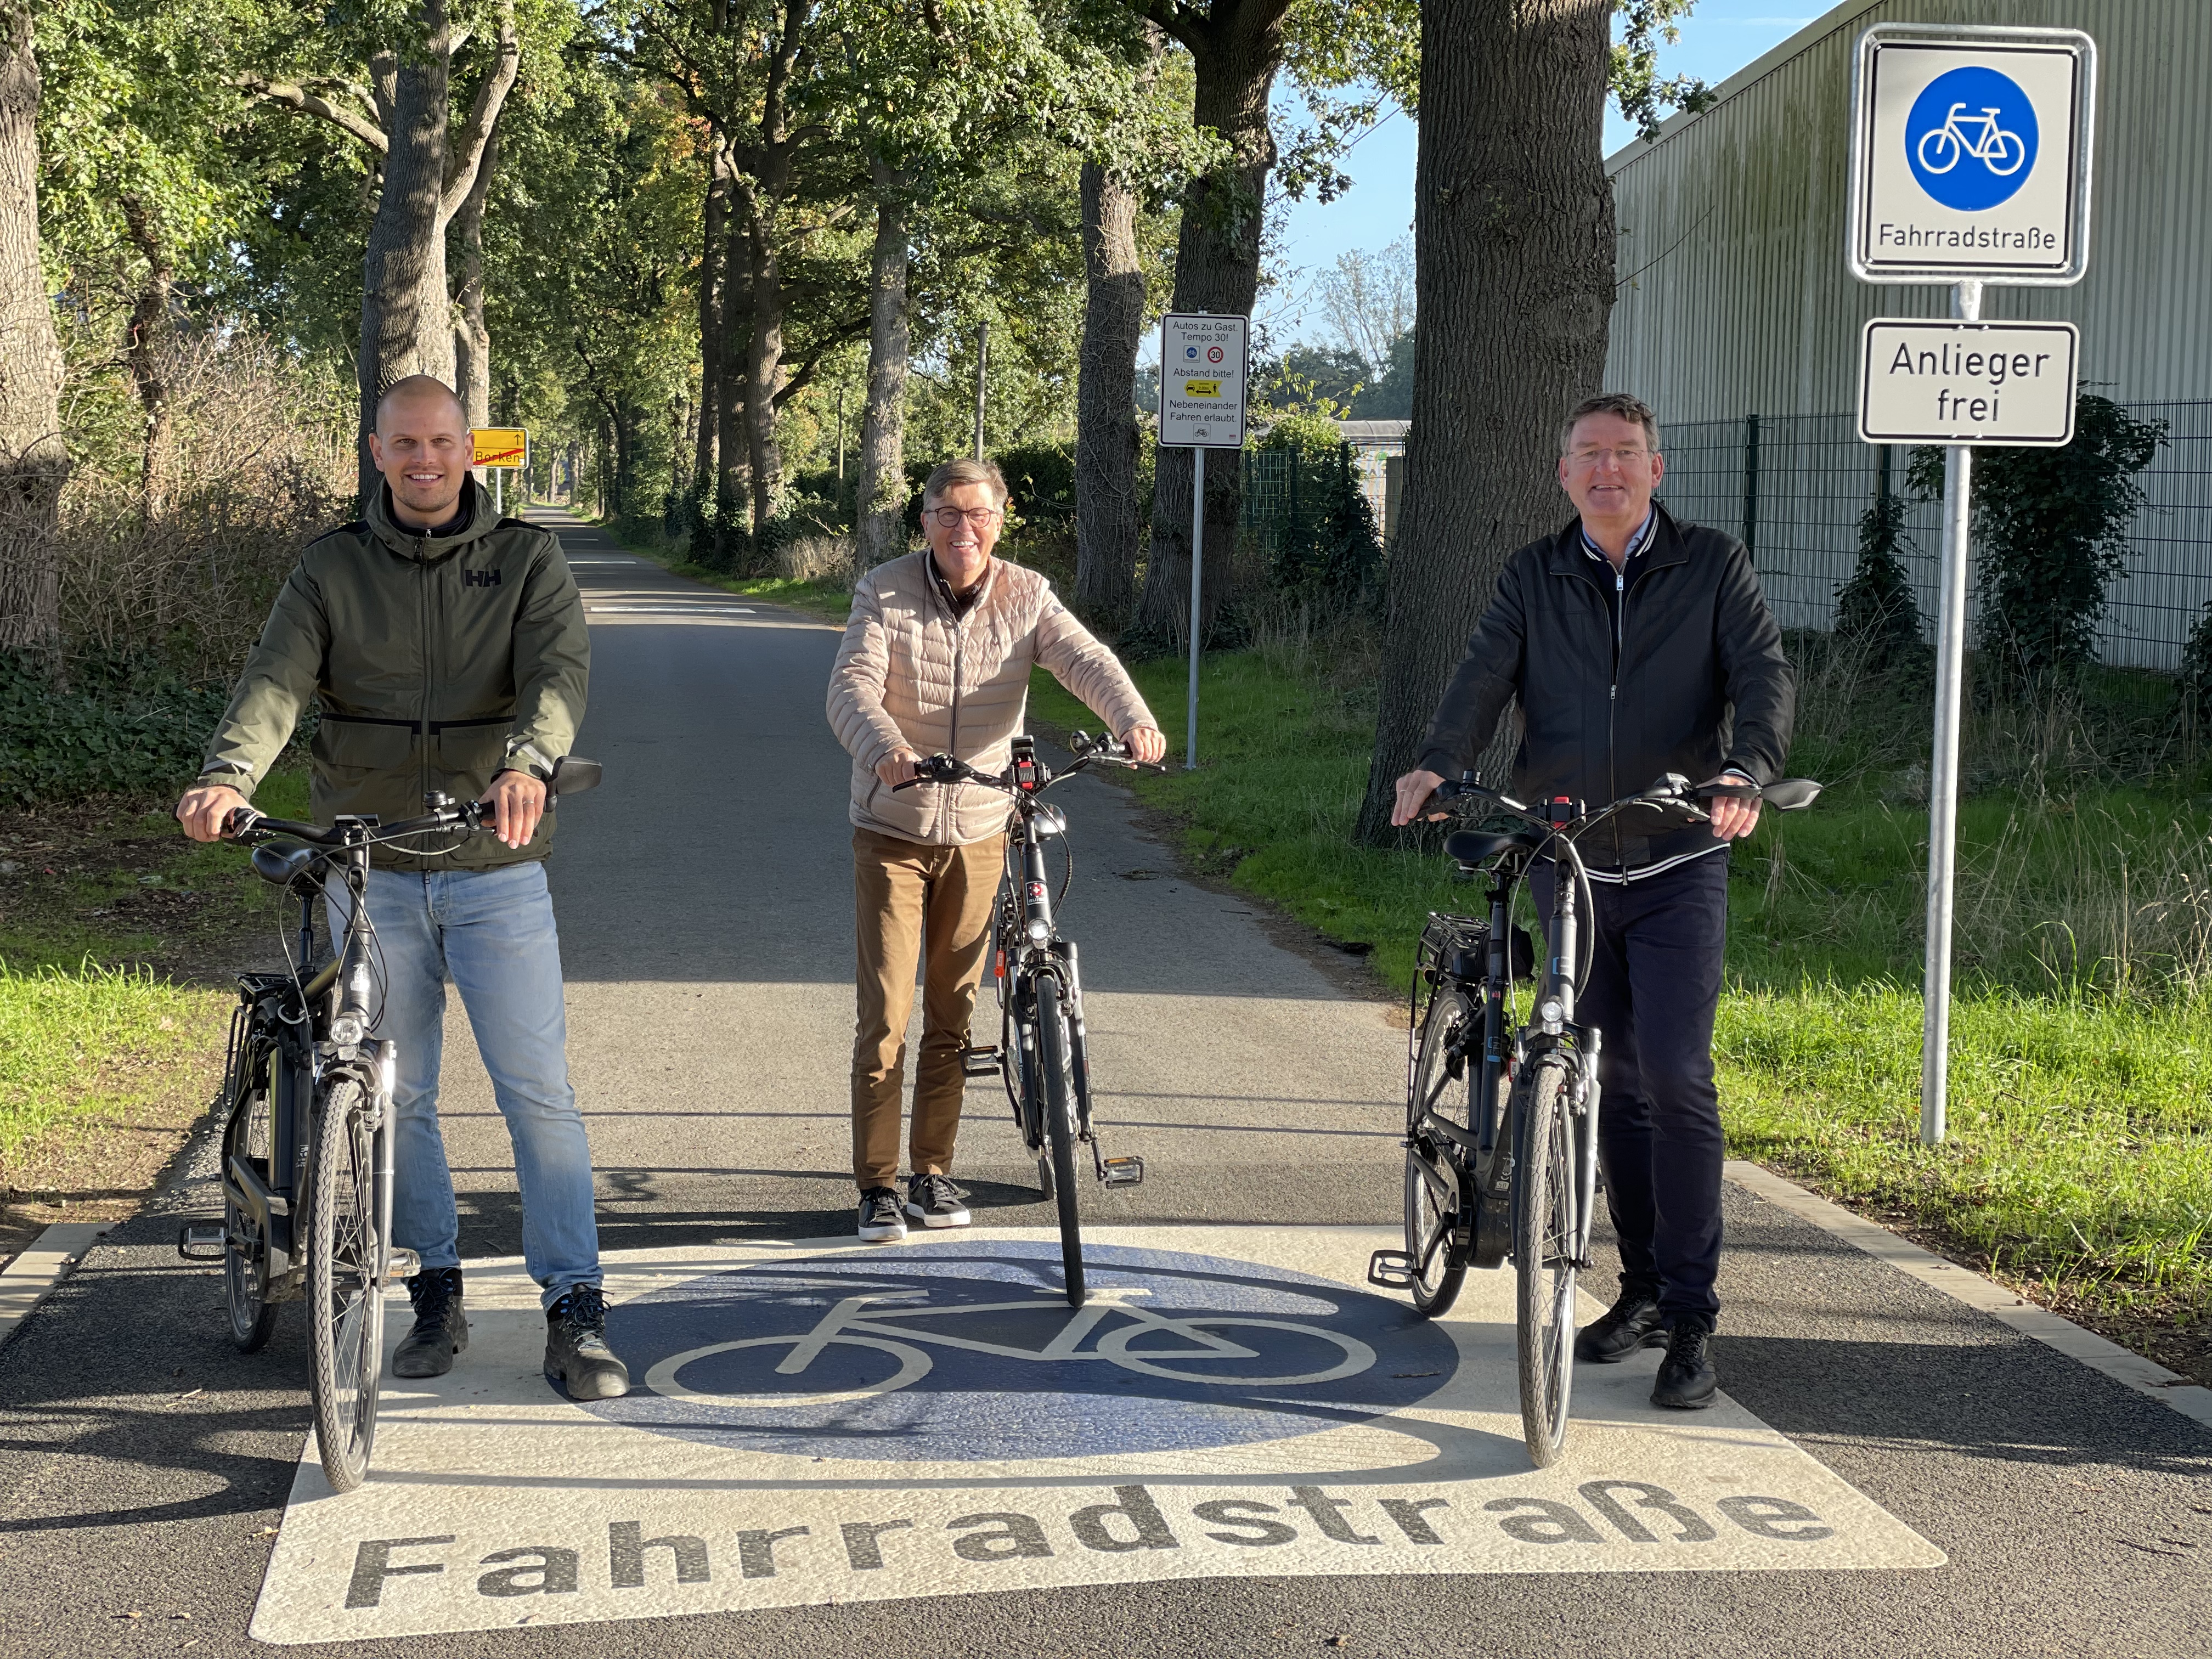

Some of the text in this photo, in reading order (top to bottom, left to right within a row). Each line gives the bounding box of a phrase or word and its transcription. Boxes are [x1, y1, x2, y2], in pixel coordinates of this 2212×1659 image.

[1879, 223, 2057, 250] Fahrradstraße
[1172, 321, 1199, 330] Autos
[1215, 323, 1238, 332] Gast.
[1181, 332, 1228, 343] Tempo 30!
[1889, 342, 2051, 385] Anlieger
[1173, 368, 1234, 379] Abstand bitte!
[1170, 399, 1238, 410] Nebeneinander
[1938, 389, 2000, 422] frei
[1170, 412, 1237, 422] Fahren erlaubt.
[476, 451, 520, 462] Borken
[465, 568, 502, 588] HH
[345, 1477, 1836, 1610] Fahrradstraße
